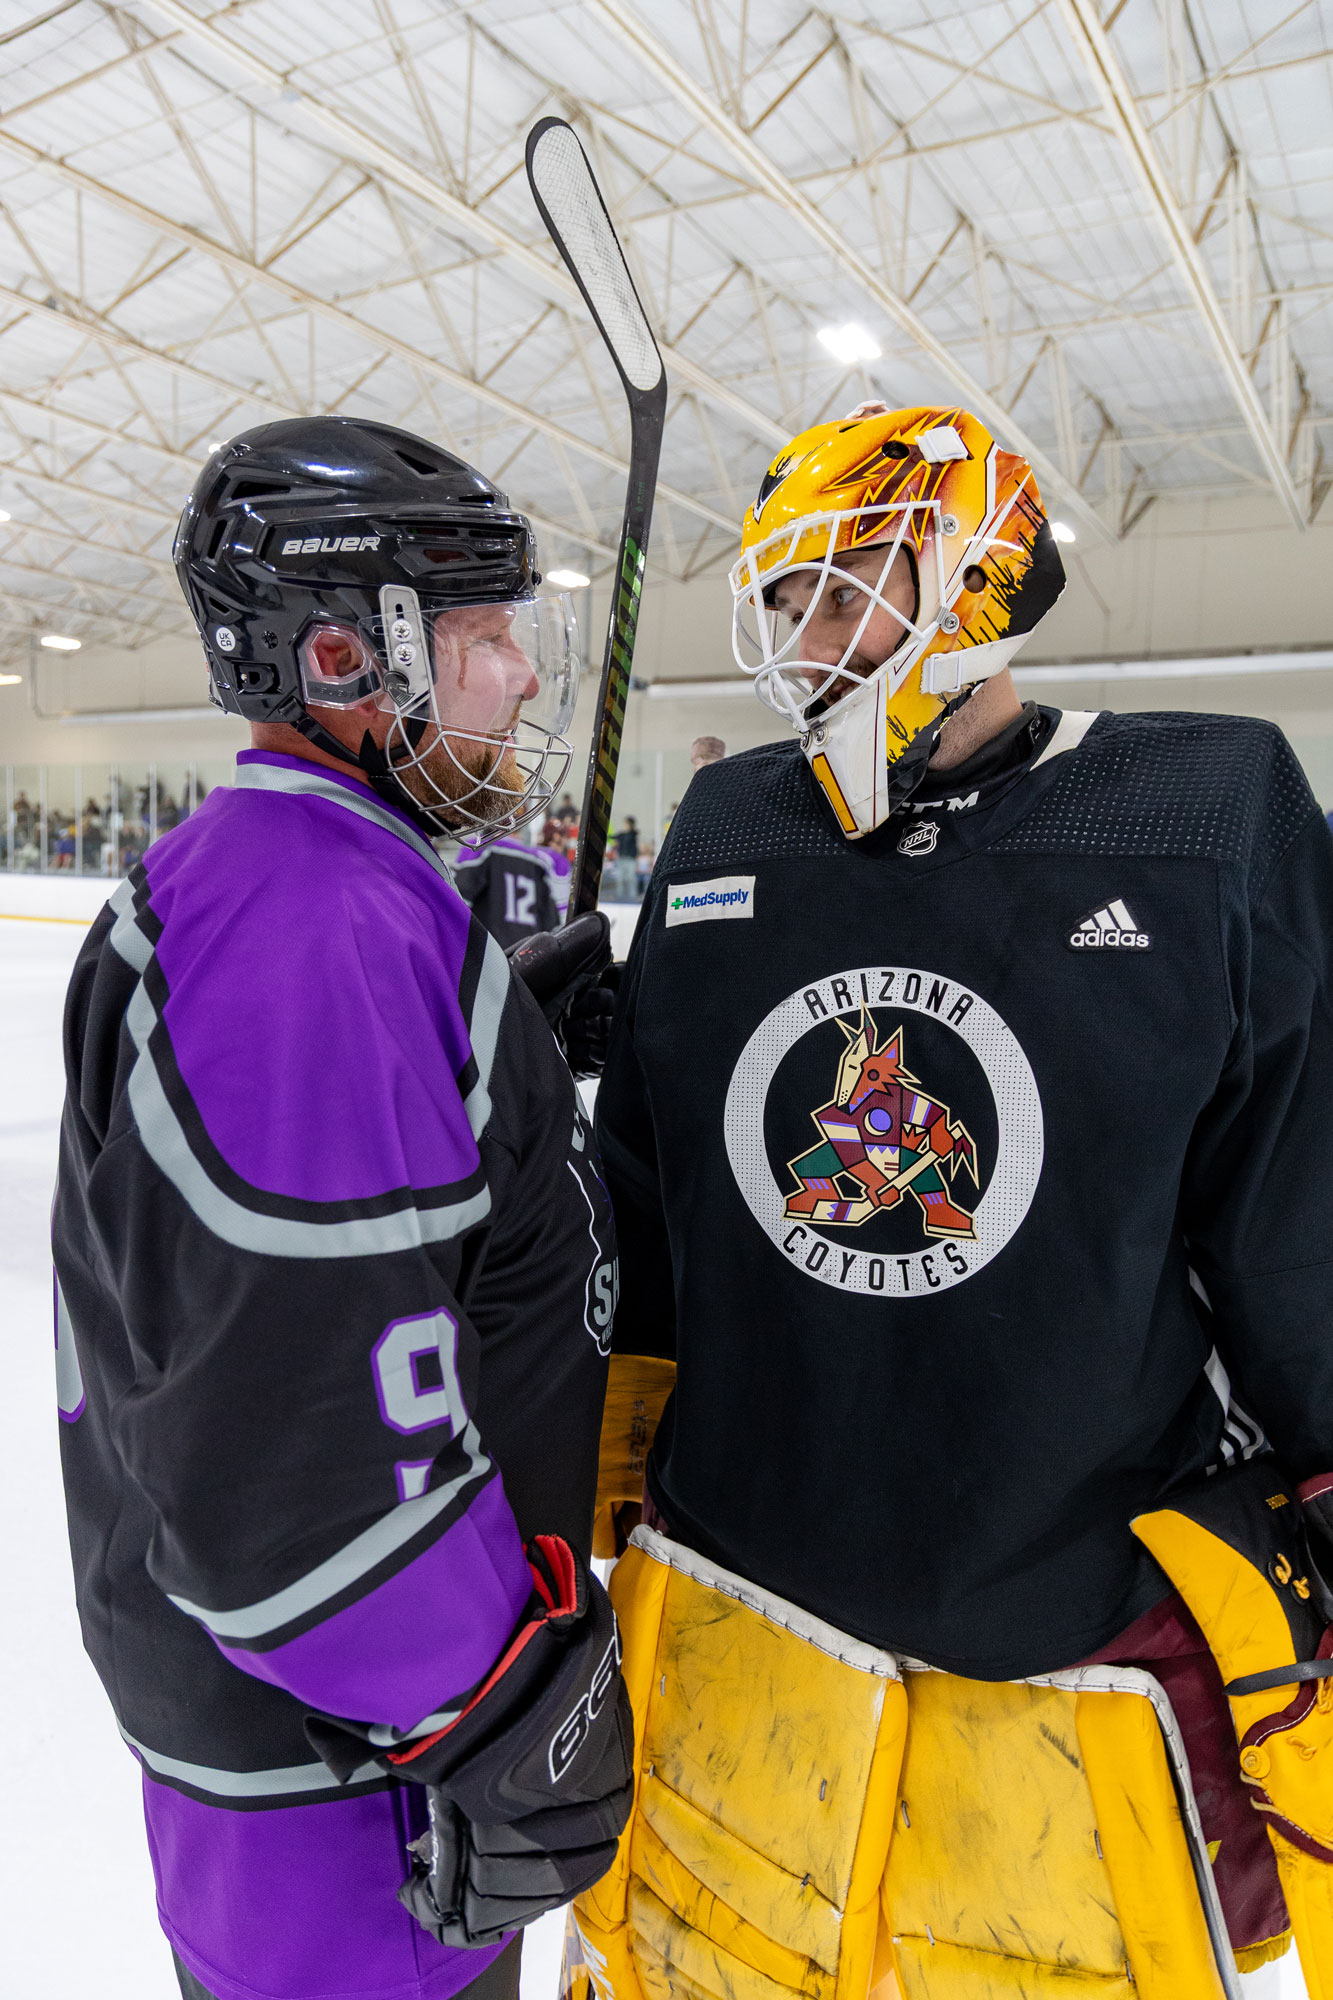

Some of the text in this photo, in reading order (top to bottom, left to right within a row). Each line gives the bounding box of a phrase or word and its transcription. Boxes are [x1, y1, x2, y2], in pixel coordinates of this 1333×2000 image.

[903, 830, 930, 848] NHL
[504, 872, 537, 927] 12
[683, 889, 749, 908] MedSupply
[1070, 929, 1149, 948] adidas
[803, 971, 975, 1026] ARIZONA
[783, 1226, 969, 1292] COYOTES
[370, 1306, 469, 1501] 9
